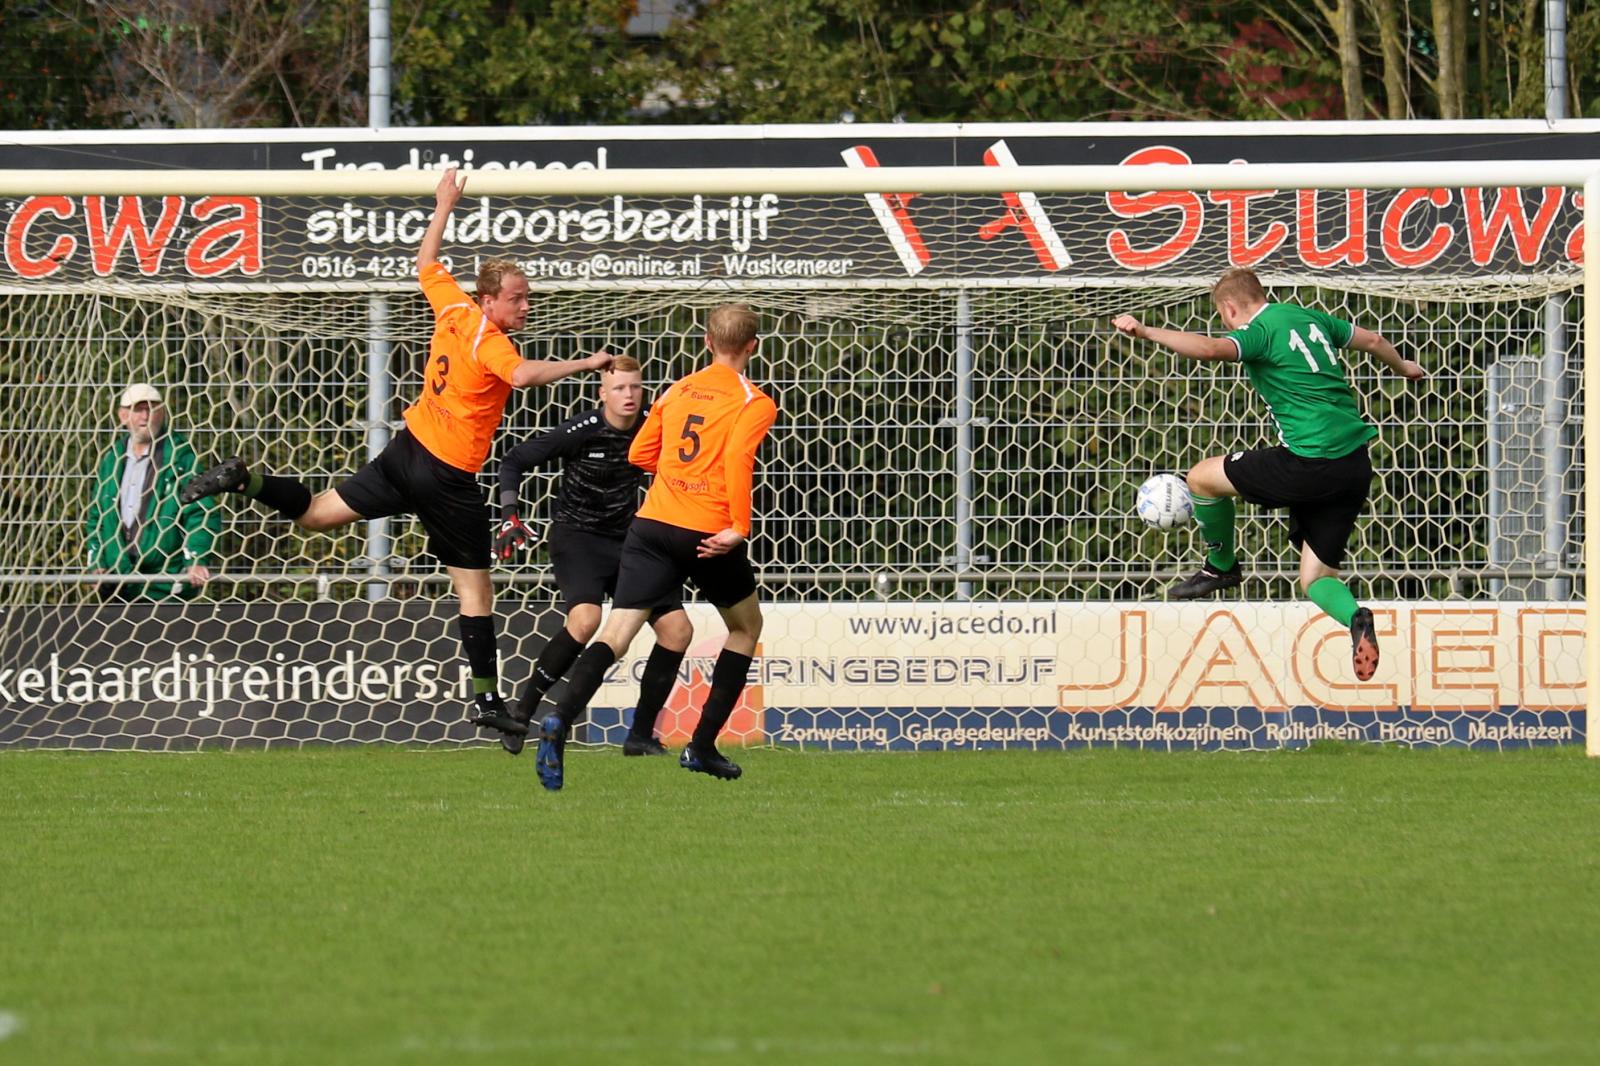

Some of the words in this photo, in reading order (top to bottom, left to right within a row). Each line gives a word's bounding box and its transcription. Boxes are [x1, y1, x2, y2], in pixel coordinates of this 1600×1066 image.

[1106, 146, 1584, 270] Stucw
[302, 256, 454, 277] 0516-42329
[723, 255, 853, 275] Waskemeer
[1289, 323, 1337, 373] 11
[432, 354, 449, 396] 3
[678, 413, 705, 463] 5
[849, 611, 1057, 640] www.jacedo.nl
[780, 723, 888, 745] Zonwering
[906, 723, 1050, 745] Garagedeuren
[1068, 722, 1247, 745] Kunststofkozijnen
[1266, 722, 1361, 741] Rolluiken
[1380, 723, 1449, 740] Horren
[1469, 722, 1573, 740] Markiezen
